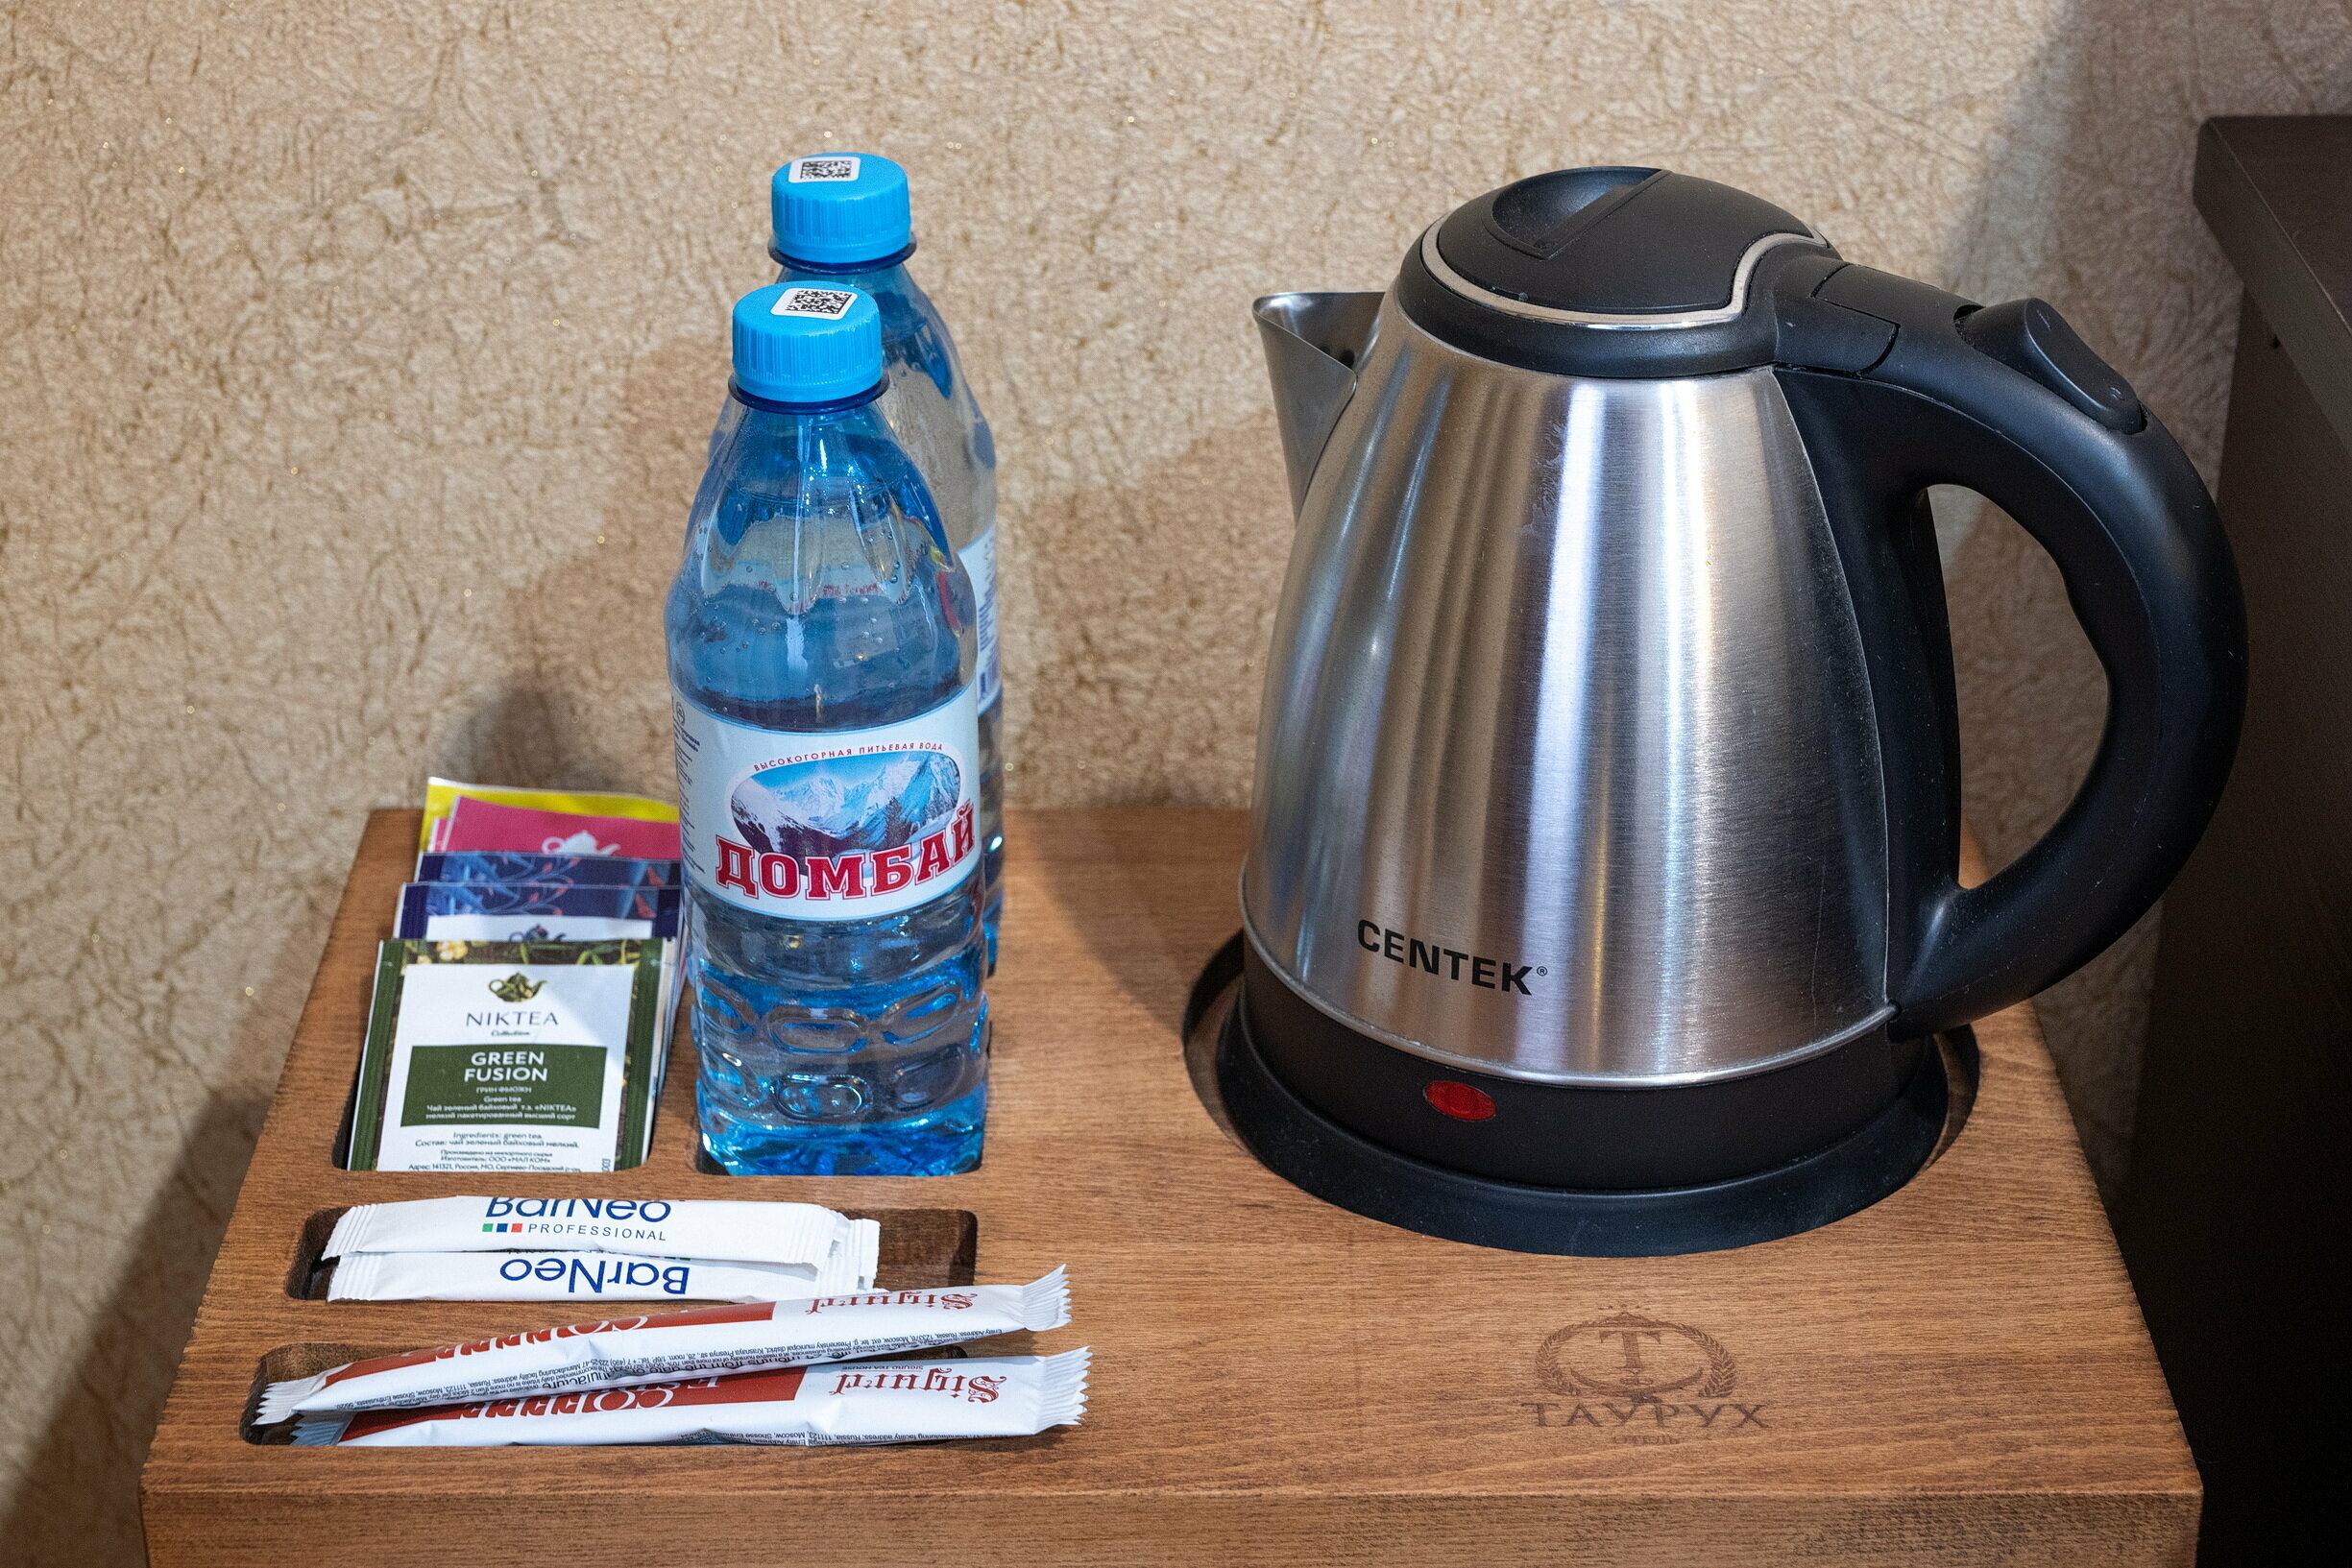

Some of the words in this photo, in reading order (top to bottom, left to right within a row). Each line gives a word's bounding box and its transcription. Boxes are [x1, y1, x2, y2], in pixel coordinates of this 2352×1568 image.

[754, 749, 852, 771] ВЫСОКОГОРНАЯ
[859, 743, 914, 755] ПИТЬЕВАЯ
[919, 742, 943, 751] ВОДА
[715, 799, 974, 901] ДОМБАЙ
[466, 1011, 559, 1026] NIKTEA
[471, 1051, 545, 1066] GREEN
[464, 1067, 547, 1082] FUSION
[527, 1223, 667, 1242] PROFESSIONAL
[499, 1258, 691, 1294] BarNeo
[805, 1291, 978, 1315] Sigurd
[882, 1335, 909, 1343] Moscow,
[934, 1331, 957, 1339] Russia,
[764, 1344, 786, 1353] district,
[786, 1342, 814, 1351] municipal
[815, 1339, 851, 1348] Presnensky
[708, 1348, 734, 1359] Presnya
[734, 1345, 764, 1356] Krasnaya
[538, 1363, 581, 1377] Manufacturing
[491, 1375, 518, 1385] address:
[518, 1371, 537, 1381] facility
[467, 1379, 490, 1387] Russia,
[829, 1367, 1006, 1404] Sigurd
[391, 1391, 415, 1400] Shosse
[415, 1387, 442, 1397] Moscow,
[773, 1430, 805, 1439] Moscow,
[806, 1429, 831, 1441] 111123,
[834, 1432, 861, 1442] Russia,
